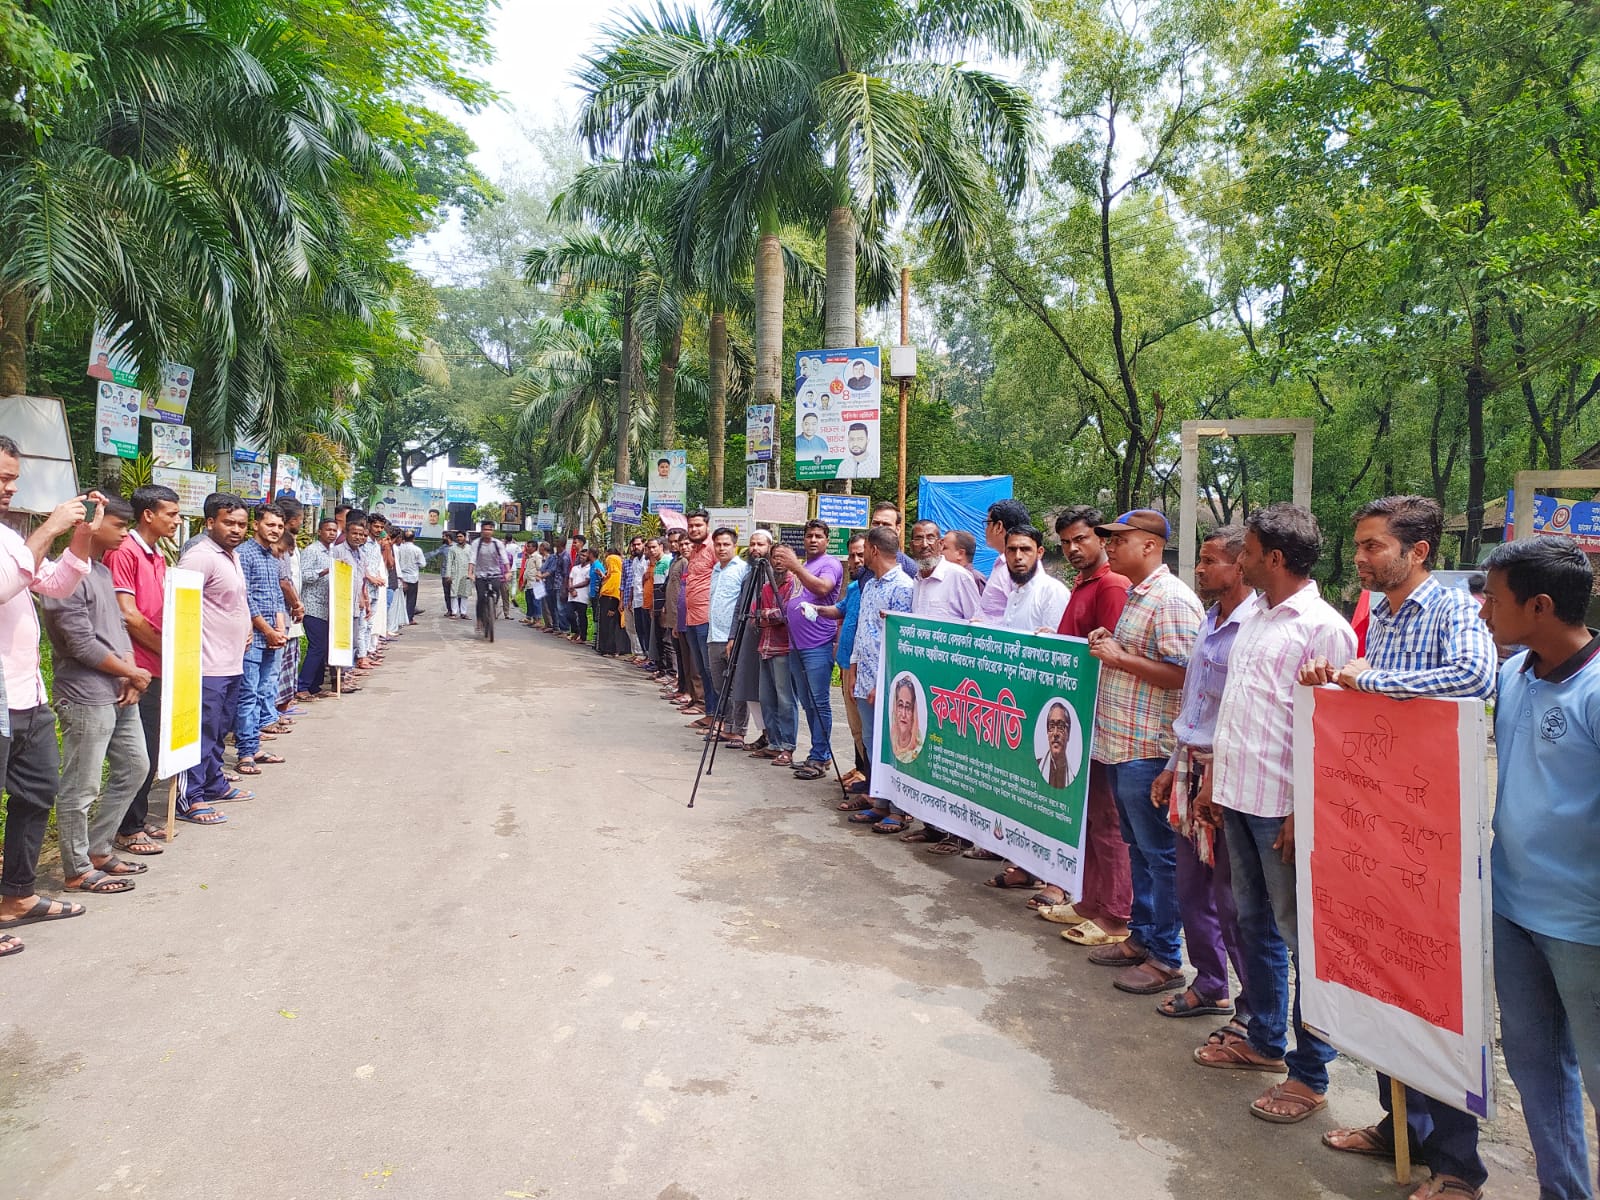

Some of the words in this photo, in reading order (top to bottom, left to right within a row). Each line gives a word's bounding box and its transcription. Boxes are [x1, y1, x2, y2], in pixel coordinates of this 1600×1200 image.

[948, 632, 972, 648] বেসরকারি
[1055, 671, 1079, 692] দাবিতে
[929, 677, 1027, 750] কর্মবিরতি
[1341, 714, 1399, 767] চাকুরী
[1393, 764, 1430, 808] চাই
[920, 789, 947, 814] বেসরকারি
[1056, 847, 1078, 874] সিলেট
